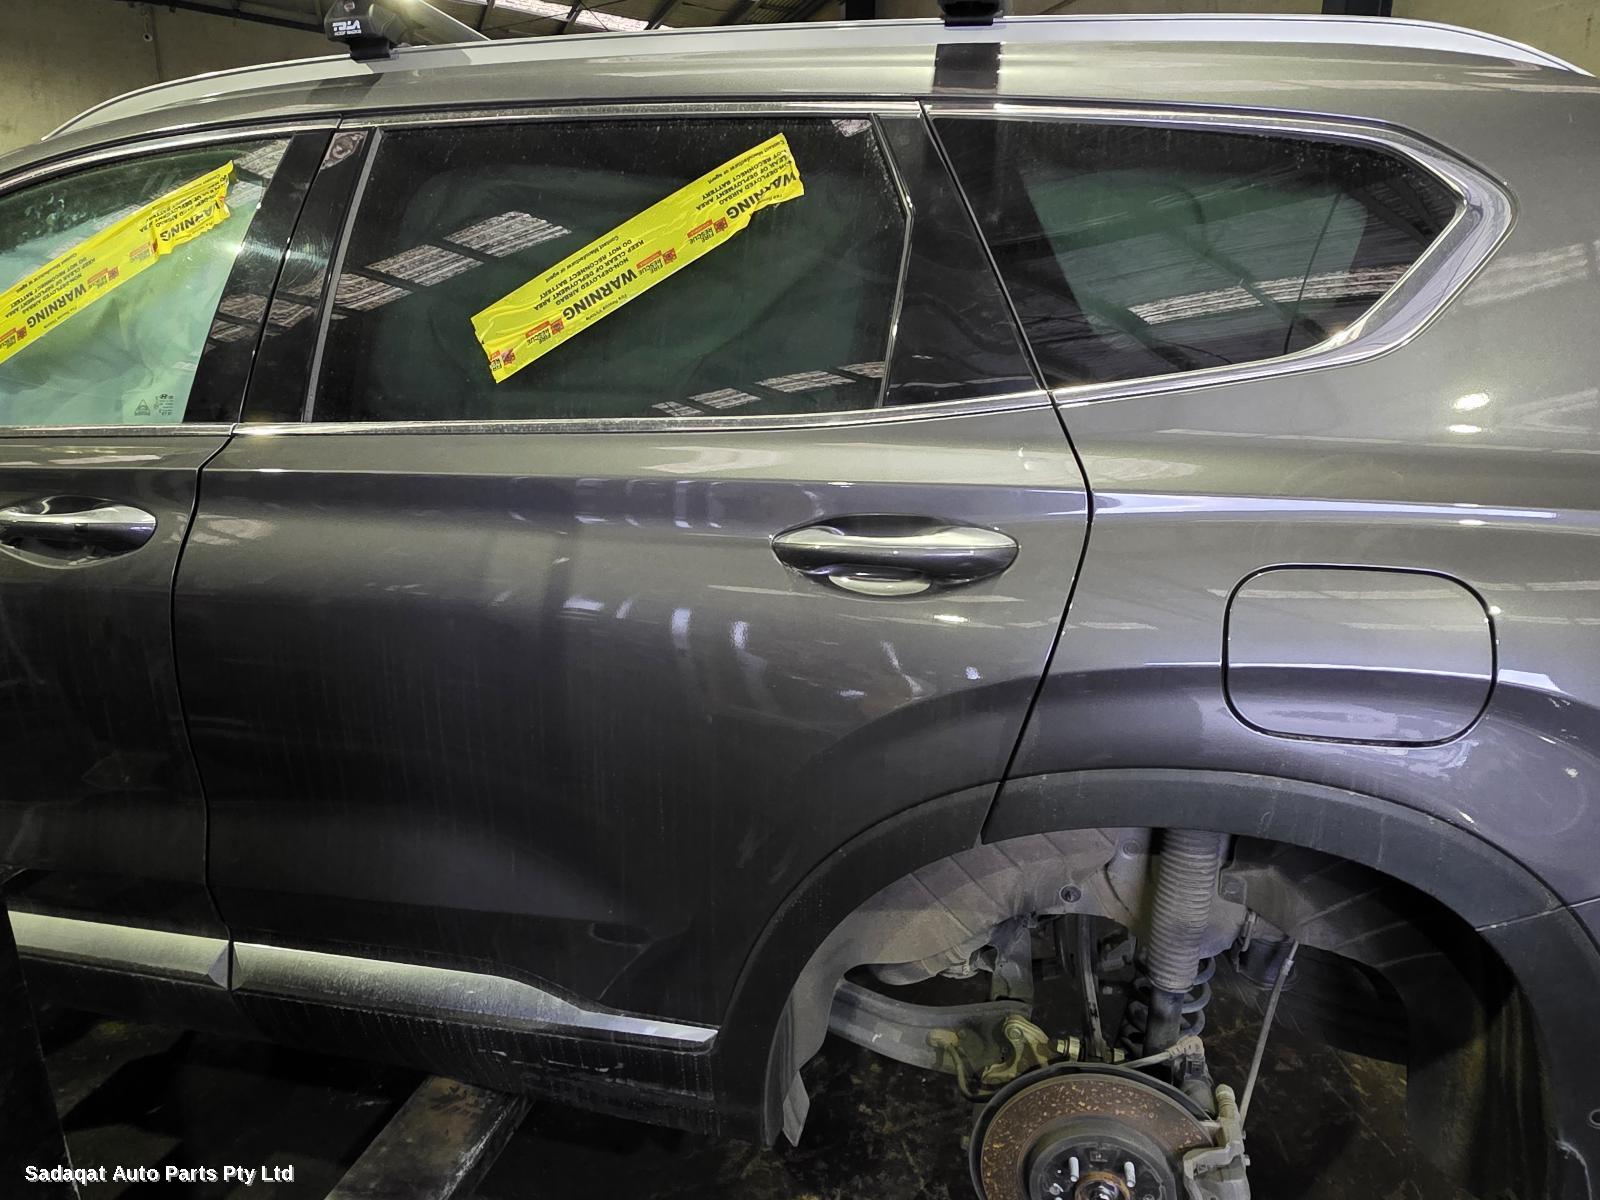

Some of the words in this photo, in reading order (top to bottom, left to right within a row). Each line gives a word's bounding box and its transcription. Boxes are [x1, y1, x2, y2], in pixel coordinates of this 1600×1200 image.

[702, 180, 730, 199] BATTERY
[715, 171, 758, 199] DEPLOYMENT
[697, 197, 714, 210] AREA
[719, 188, 743, 204] AIRBAG
[608, 245, 622, 256] NOT
[622, 238, 632, 247] DO
[626, 240, 644, 252] KEEP
[605, 251, 625, 266] CLEAR
[568, 255, 607, 280] RECONNECT
[580, 257, 629, 290] NON-DEPLOYED
[595, 264, 604, 272] OF
[545, 271, 560, 283] agent
[552, 271, 594, 298] DEPLOYMENT
[539, 279, 567, 299] BATTERY
[555, 288, 579, 305] AIRBAG
[562, 268, 637, 320] WARNING
[25, 284, 87, 327] WARNING
[535, 298, 551, 310] AREA
